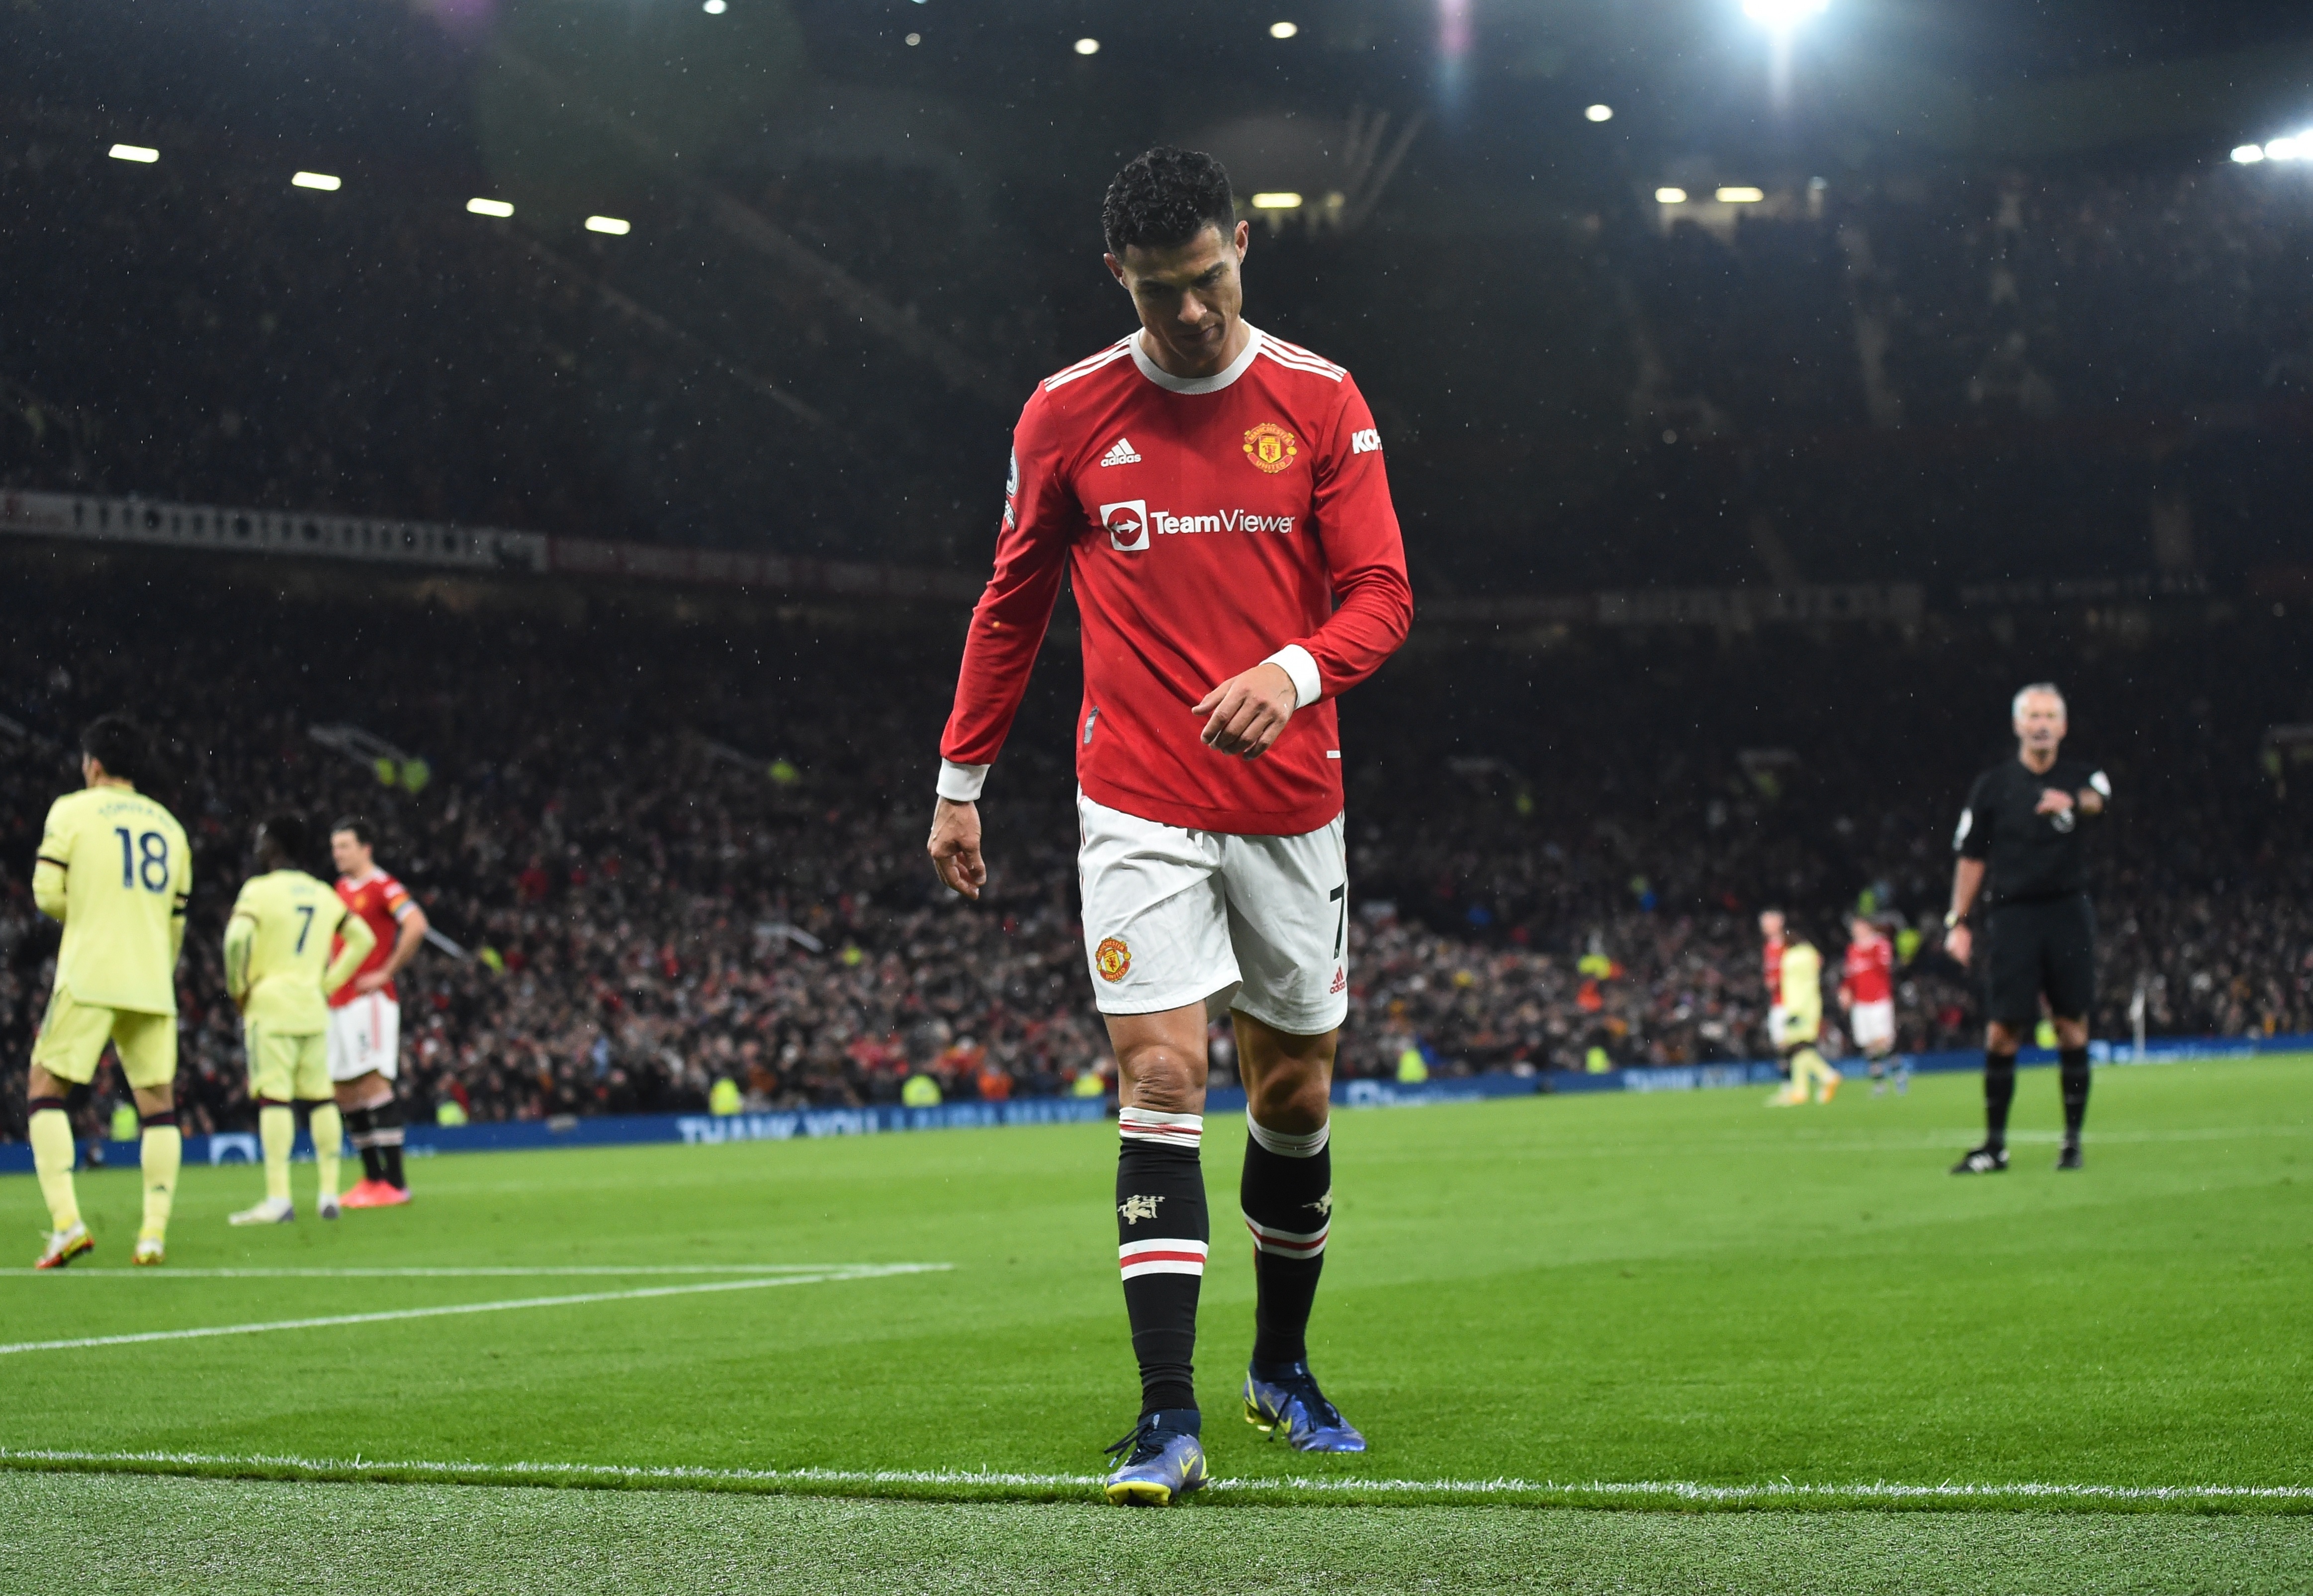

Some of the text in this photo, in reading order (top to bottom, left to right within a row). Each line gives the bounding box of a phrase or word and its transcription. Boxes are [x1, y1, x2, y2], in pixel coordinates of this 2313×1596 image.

[1248, 426, 1291, 443] MANCHESTER
[1100, 454, 1142, 467] adidas
[1256, 460, 1286, 470] UNITED
[1150, 509, 1295, 534] TeamViewer
[115, 827, 169, 894] 18
[295, 905, 314, 955] 7
[1330, 882, 1345, 960] 7
[1105, 967, 1126, 979] UNITED
